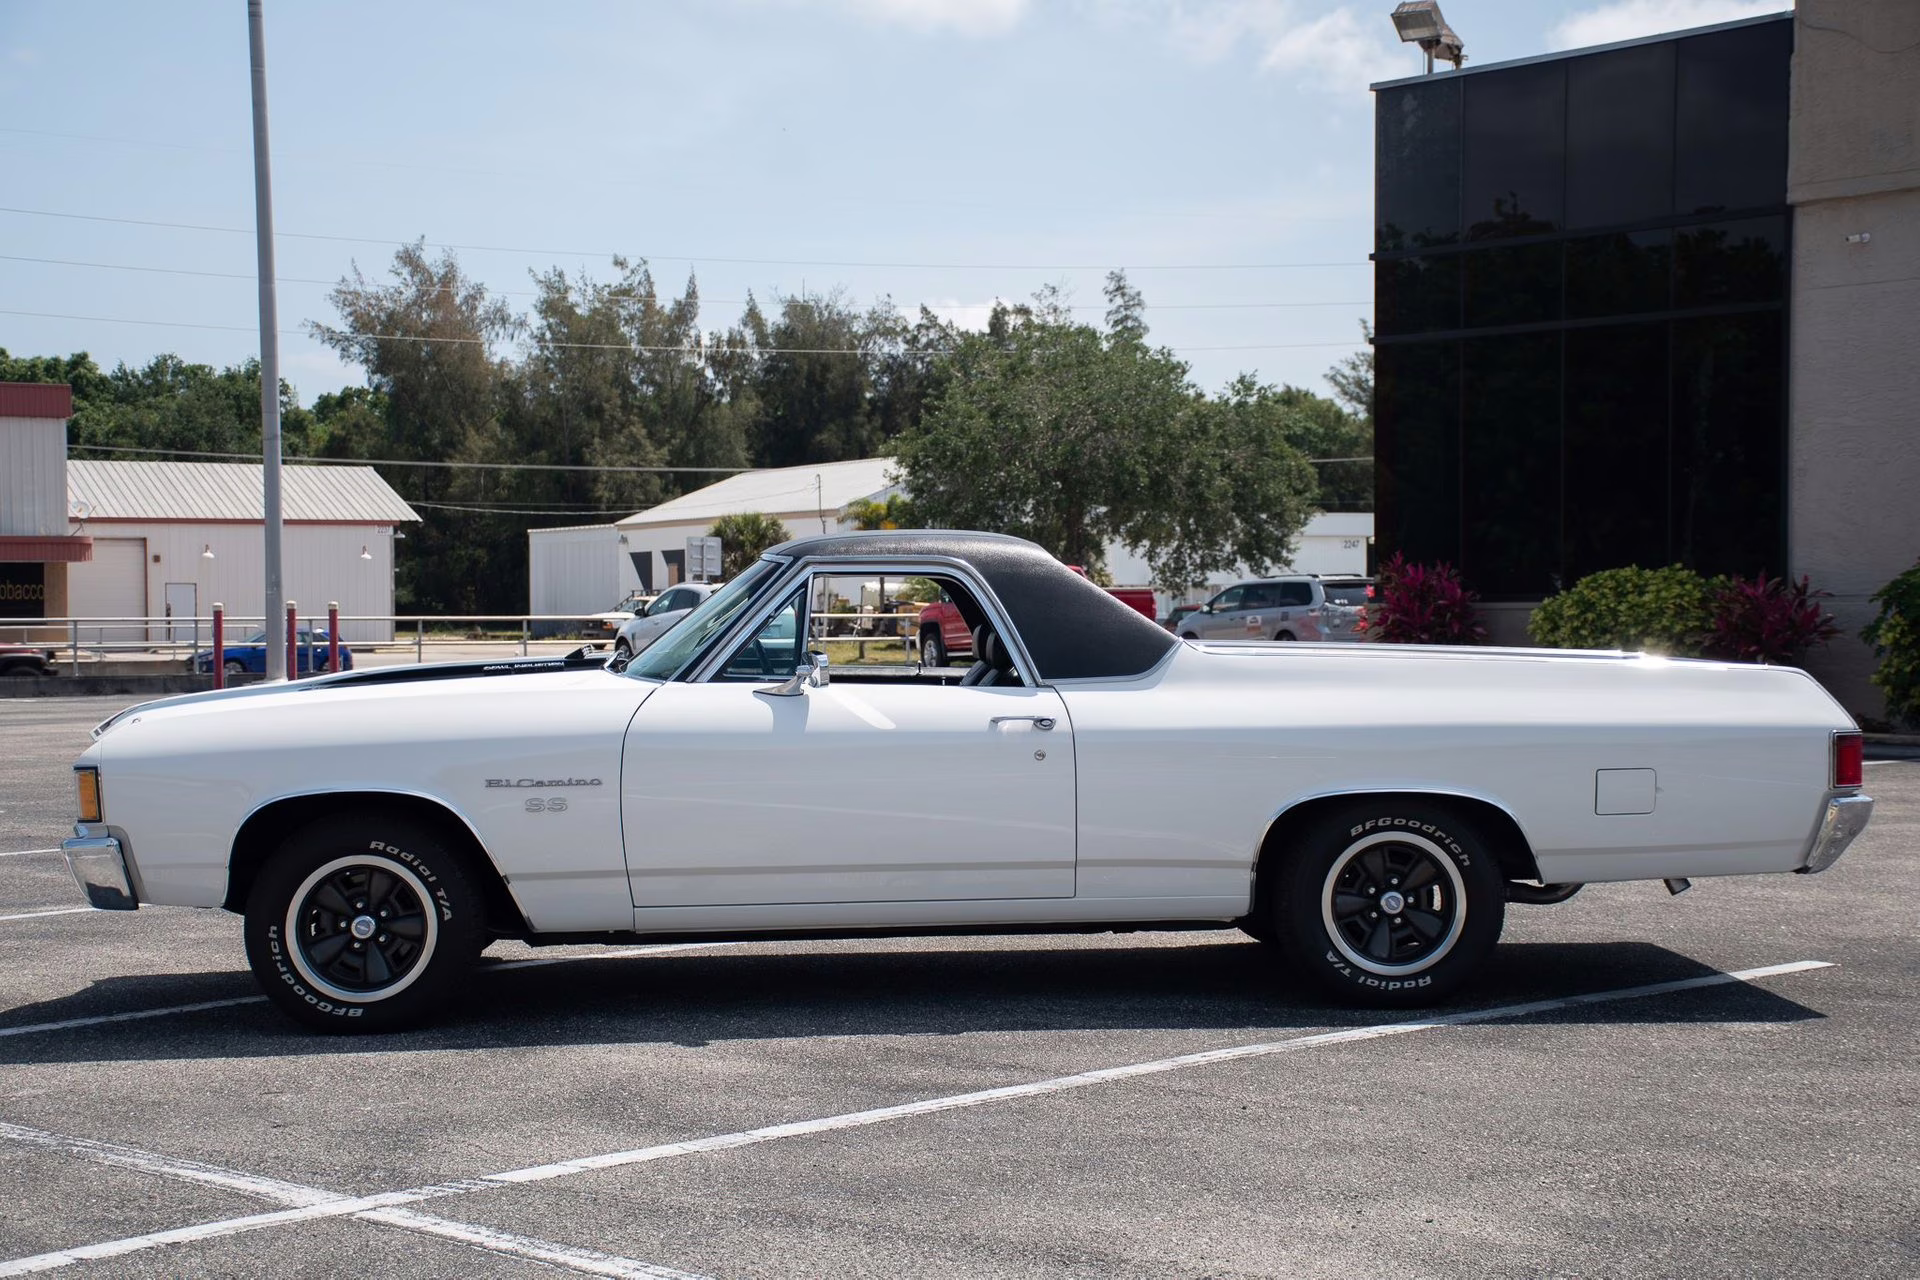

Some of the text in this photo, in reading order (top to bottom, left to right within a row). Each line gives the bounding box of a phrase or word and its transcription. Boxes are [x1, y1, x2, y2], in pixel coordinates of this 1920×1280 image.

[525, 797, 568, 813] SS
[1350, 817, 1470, 867] BFGoodrich
[369, 840, 453, 922] Radial T/A
[268, 925, 364, 1018] BFGoodrich
[1325, 950, 1432, 991] Radial T/A
